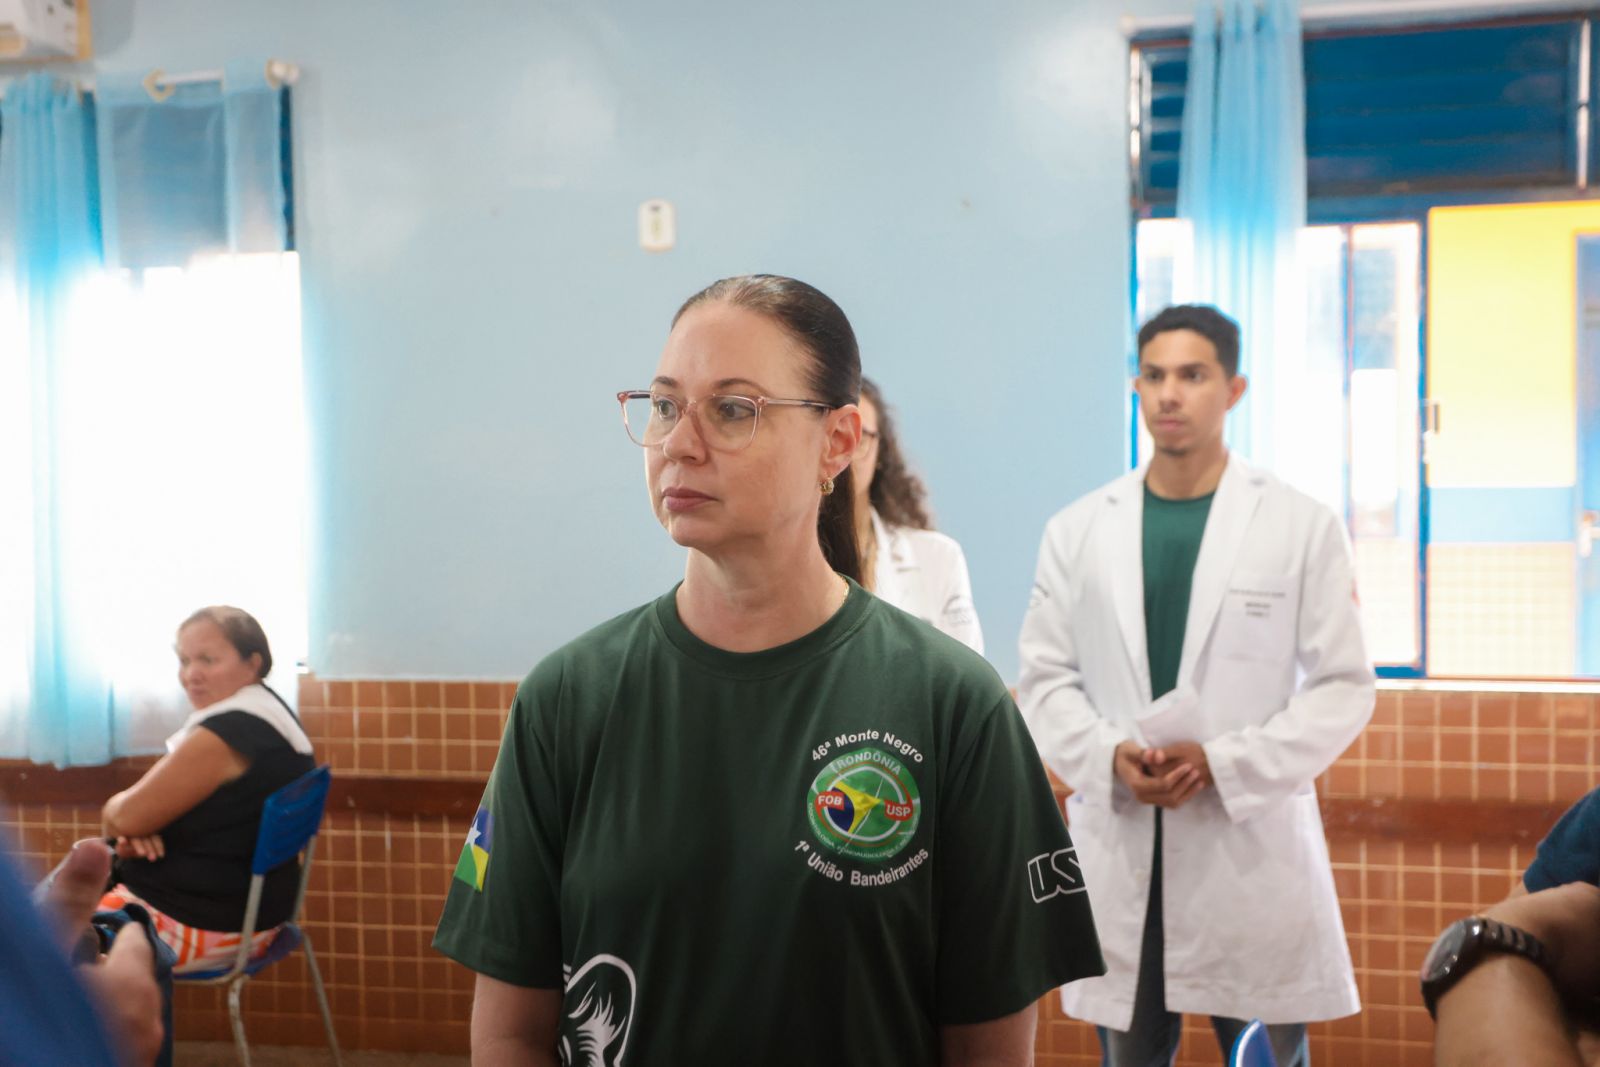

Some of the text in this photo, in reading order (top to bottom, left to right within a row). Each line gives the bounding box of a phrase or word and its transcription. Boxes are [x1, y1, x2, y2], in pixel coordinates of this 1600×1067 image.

[835, 728, 880, 748] Monte
[883, 731, 924, 764] Negro
[837, 750, 902, 776] RONDÔNIA
[817, 794, 844, 806] FOB
[885, 804, 912, 818] USP
[807, 851, 844, 882] União
[850, 847, 930, 887] Bandeirantes
